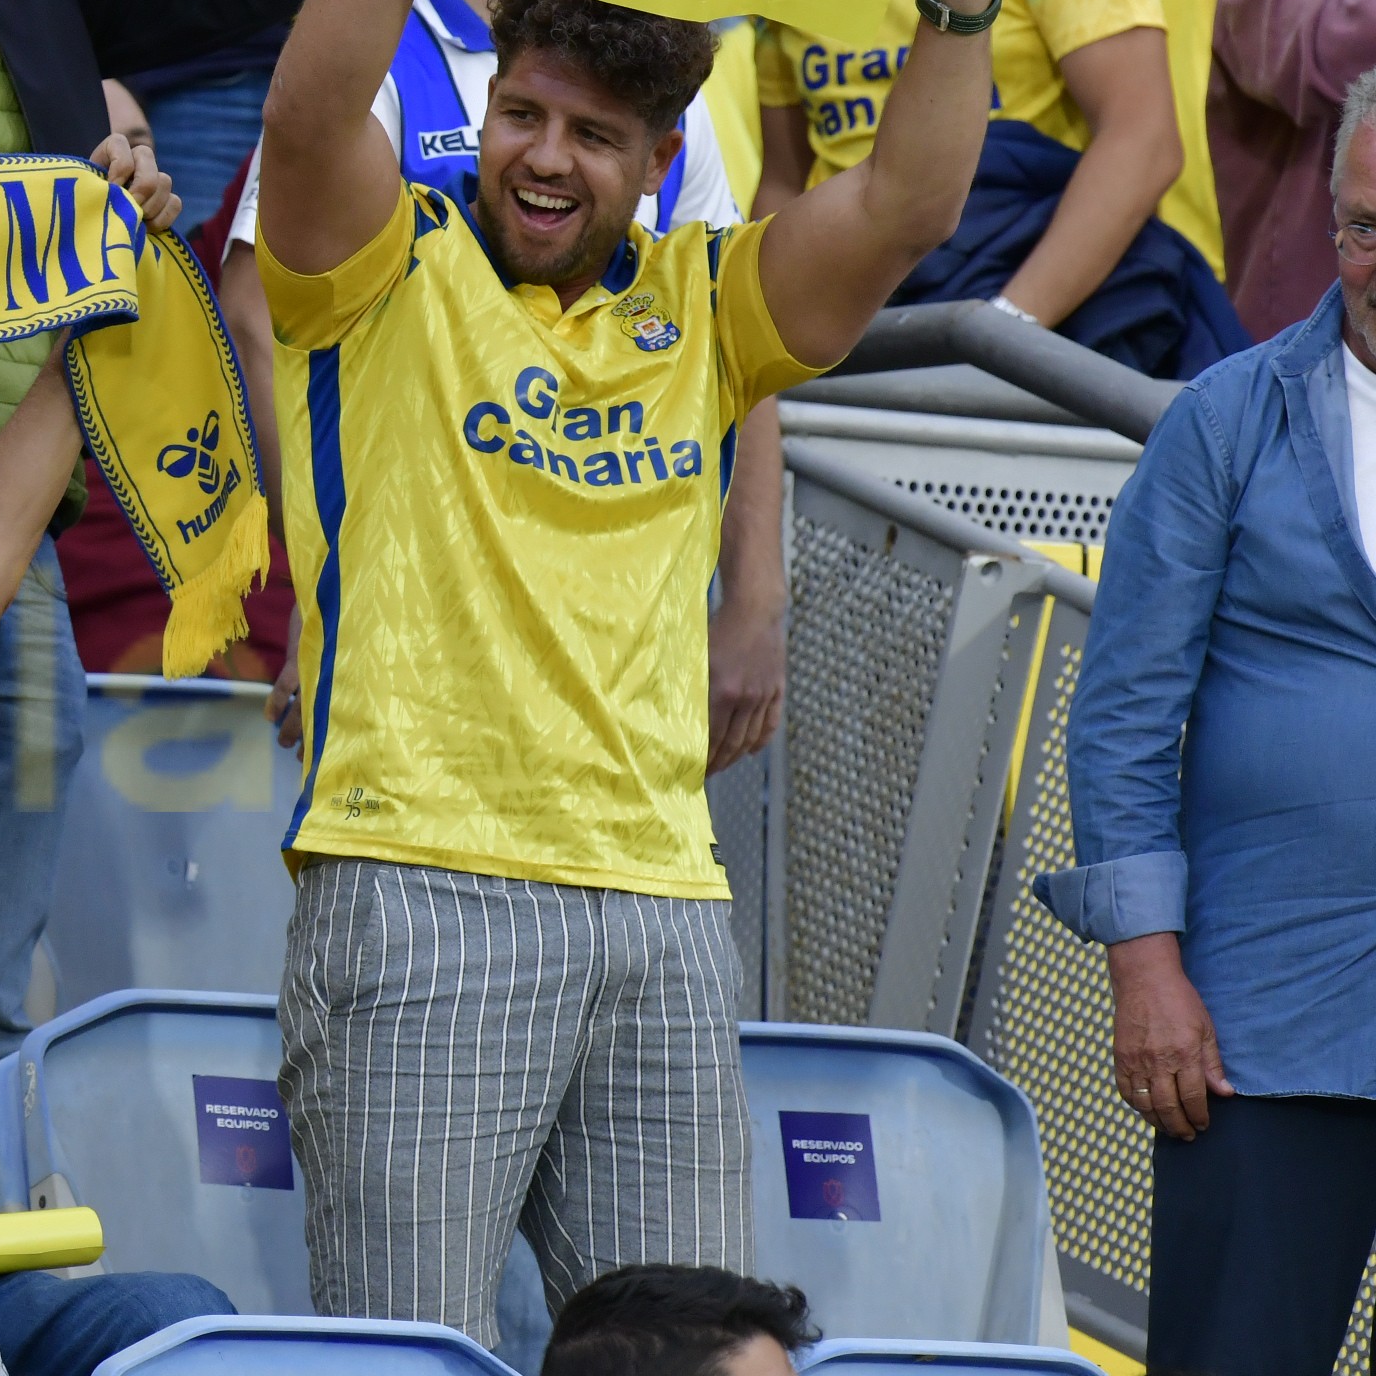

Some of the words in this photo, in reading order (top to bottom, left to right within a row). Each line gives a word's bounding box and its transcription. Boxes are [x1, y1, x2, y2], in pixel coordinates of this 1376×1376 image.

[420, 130, 482, 158] KEL
[462, 401, 703, 487] Canaria
[176, 458, 242, 544] hummel
[205, 1104, 279, 1119] RESERVADO
[216, 1118, 270, 1131] EQUIPOS
[791, 1139, 864, 1152] RESERVADO
[803, 1152, 856, 1164] EQUIPOS
